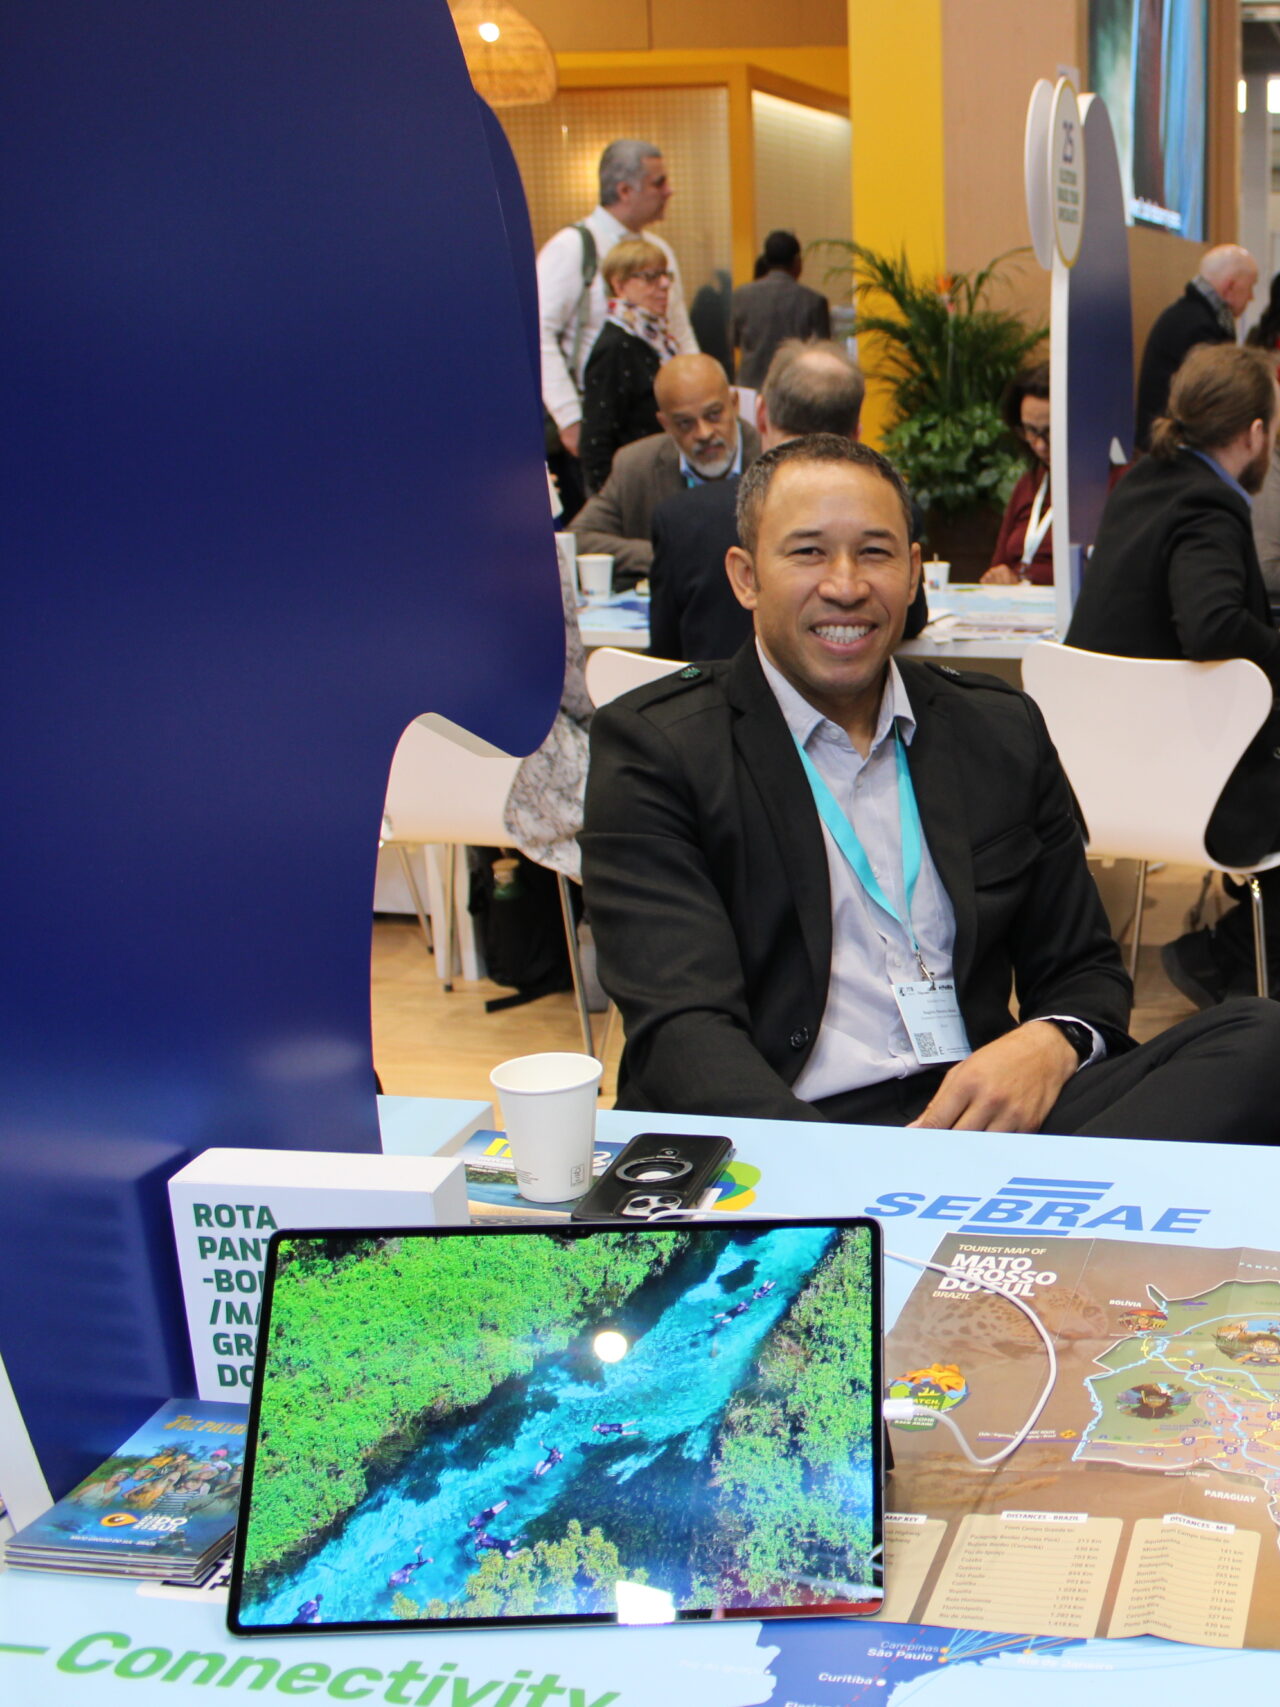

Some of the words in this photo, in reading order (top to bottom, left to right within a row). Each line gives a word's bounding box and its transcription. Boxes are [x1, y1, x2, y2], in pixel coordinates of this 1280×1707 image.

[193, 1203, 279, 1229] ROTA
[864, 1191, 1212, 1234] SEBRAE
[959, 1244, 1003, 1254] TOURIST
[1004, 1246, 1030, 1255] MAP
[951, 1253, 1032, 1271] MATO
[938, 1277, 980, 1293] DO
[932, 1291, 971, 1301] BRAZIL
[213, 1332, 255, 1356] GR
[1204, 1489, 1256, 1503] PARAGUAY
[884, 1514, 903, 1522] MAP
[1006, 1512, 1047, 1521] DISTANCES
[1053, 1514, 1080, 1522] BRAZIL
[1169, 1516, 1210, 1529] DISTANCES
[880, 1640, 939, 1653] Campinas
[867, 1648, 893, 1659] São
[896, 1652, 934, 1662] Paulo
[56, 1631, 621, 1707] Connectivity
[818, 1672, 873, 1686] Curitiba
